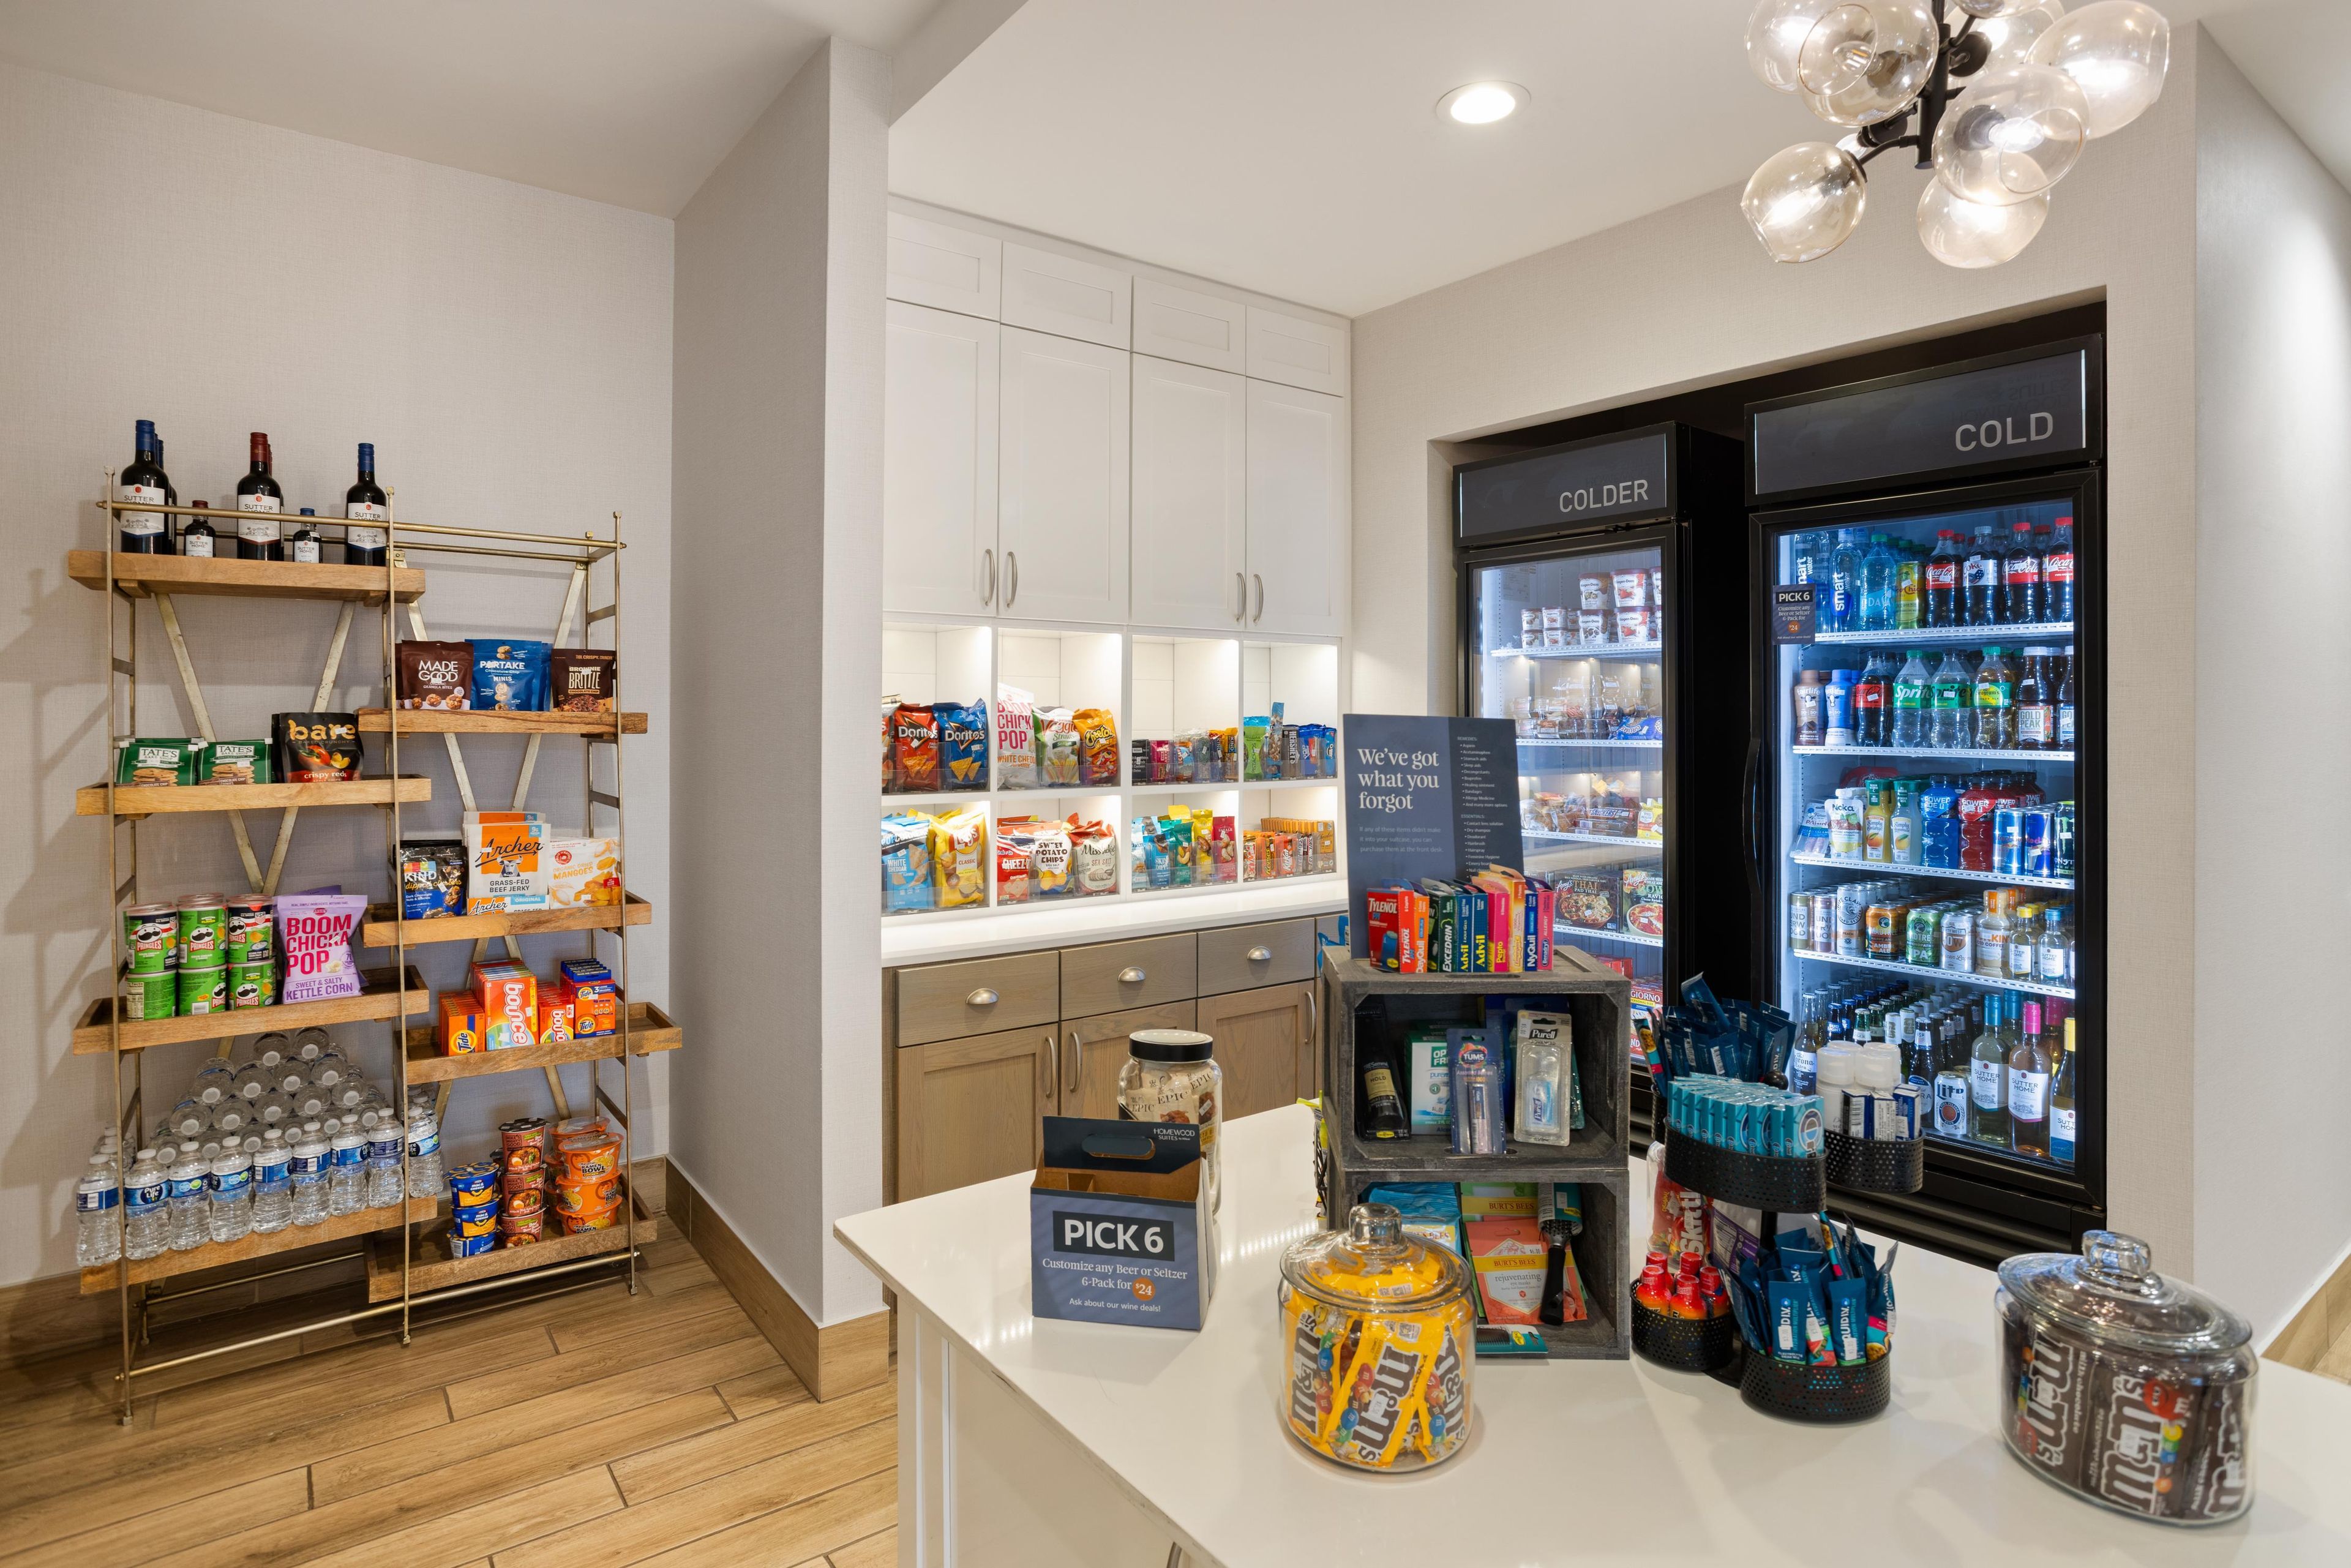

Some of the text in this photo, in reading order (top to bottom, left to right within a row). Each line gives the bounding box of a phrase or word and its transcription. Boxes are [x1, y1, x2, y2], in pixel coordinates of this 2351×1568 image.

[1955, 411, 2053, 451] COLD
[124, 495, 155, 504] SUTTER
[1559, 479, 1648, 513] COLDER
[244, 503, 274, 512] SUTTER
[354, 511, 381, 520] SUTTER
[1779, 592, 1810, 602] PICK 6
[1832, 572, 1844, 612] smart
[419, 661, 458, 671] MADE
[480, 661, 525, 669] PARTAKE
[419, 671, 458, 682] GOOD
[568, 672, 601, 689] BRITTLE
[1797, 686, 1821, 696] fairlife
[1895, 685, 1931, 700] Sprite
[2020, 711, 2041, 719] GOLD
[2020, 719, 2041, 728] PEAK
[288, 719, 355, 740] bare
[898, 726, 938, 738] Doritos
[945, 729, 985, 741] Doritos
[999, 730, 1027, 749] POP
[141, 748, 178, 758] TATE'S
[218, 745, 252, 754] TATE'S
[997, 754, 1017, 763] WHITE
[1357, 748, 1439, 770] We've got
[1358, 770, 1440, 791] what you
[1359, 792, 1414, 813] forgot
[1832, 803, 1854, 812] Noka
[477, 836, 544, 860] Archer
[1081, 844, 1101, 856] Miss
[553, 865, 572, 873] ORGANIC
[553, 866, 593, 880] MANGOES
[404, 871, 437, 882] KIND
[1625, 876, 1645, 887] Amy's
[1556, 880, 1597, 892] Amy's THAI
[1368, 898, 1397, 914] TYLENOL
[1844, 896, 1862, 906] CLAW
[470, 899, 508, 915] Archer
[287, 914, 351, 936] BOOM
[137, 940, 162, 950] PRINGLES
[190, 940, 214, 950] PRINGLES
[287, 931, 349, 953] CHICKA
[1442, 925, 1452, 972] EXCEDRIN
[1475, 934, 1485, 967] Advil
[1526, 935, 1537, 967] NyQuil
[1415, 940, 1425, 973] DayQuil
[1460, 945, 1469, 972] Advil
[1910, 950, 1929, 959] IPA
[287, 950, 330, 978] POP
[324, 977, 343, 986] SALTY
[286, 982, 353, 1001] KETTLE CORN
[579, 988, 592, 999] Tide
[1630, 991, 1660, 1002] GIORNO
[236, 997, 259, 1007] PRINGLES
[503, 981, 528, 1045] bounce
[578, 1021, 594, 1031] Tide
[1532, 1030, 1556, 1040] Purell
[457, 1032, 473, 1054] Tide
[1794, 1054, 1814, 1065] Corona
[1974, 1068, 2000, 1078] SUTTER
[1190, 1071, 1213, 1090] EPIC
[2012, 1078, 2038, 1088] SUTTER
[1157, 1090, 1189, 1105] EPIC
[1131, 1103, 1155, 1112] EPIC
[1532, 1098, 1543, 1122] Purell
[1153, 1128, 1195, 1136] HOMEWOOD
[144, 1184, 162, 1194] Pure
[1064, 1219, 1164, 1253] PICK 6
[1042, 1258, 1094, 1272] Customize
[1095, 1264, 1114, 1275] any
[1116, 1264, 1138, 1275] Beer
[1153, 1266, 1188, 1280] Seltzer
[1495, 1272, 1542, 1283] rejuvenating
[1081, 1277, 1152, 1296] 6-Pack for $24
[1069, 1297, 1082, 1306] Ask
[1083, 1299, 1104, 1308] about
[1139, 1303, 1161, 1313] deals!
[1780, 1307, 1791, 1317] I.V.
[1840, 1307, 1850, 1316] I.V.
